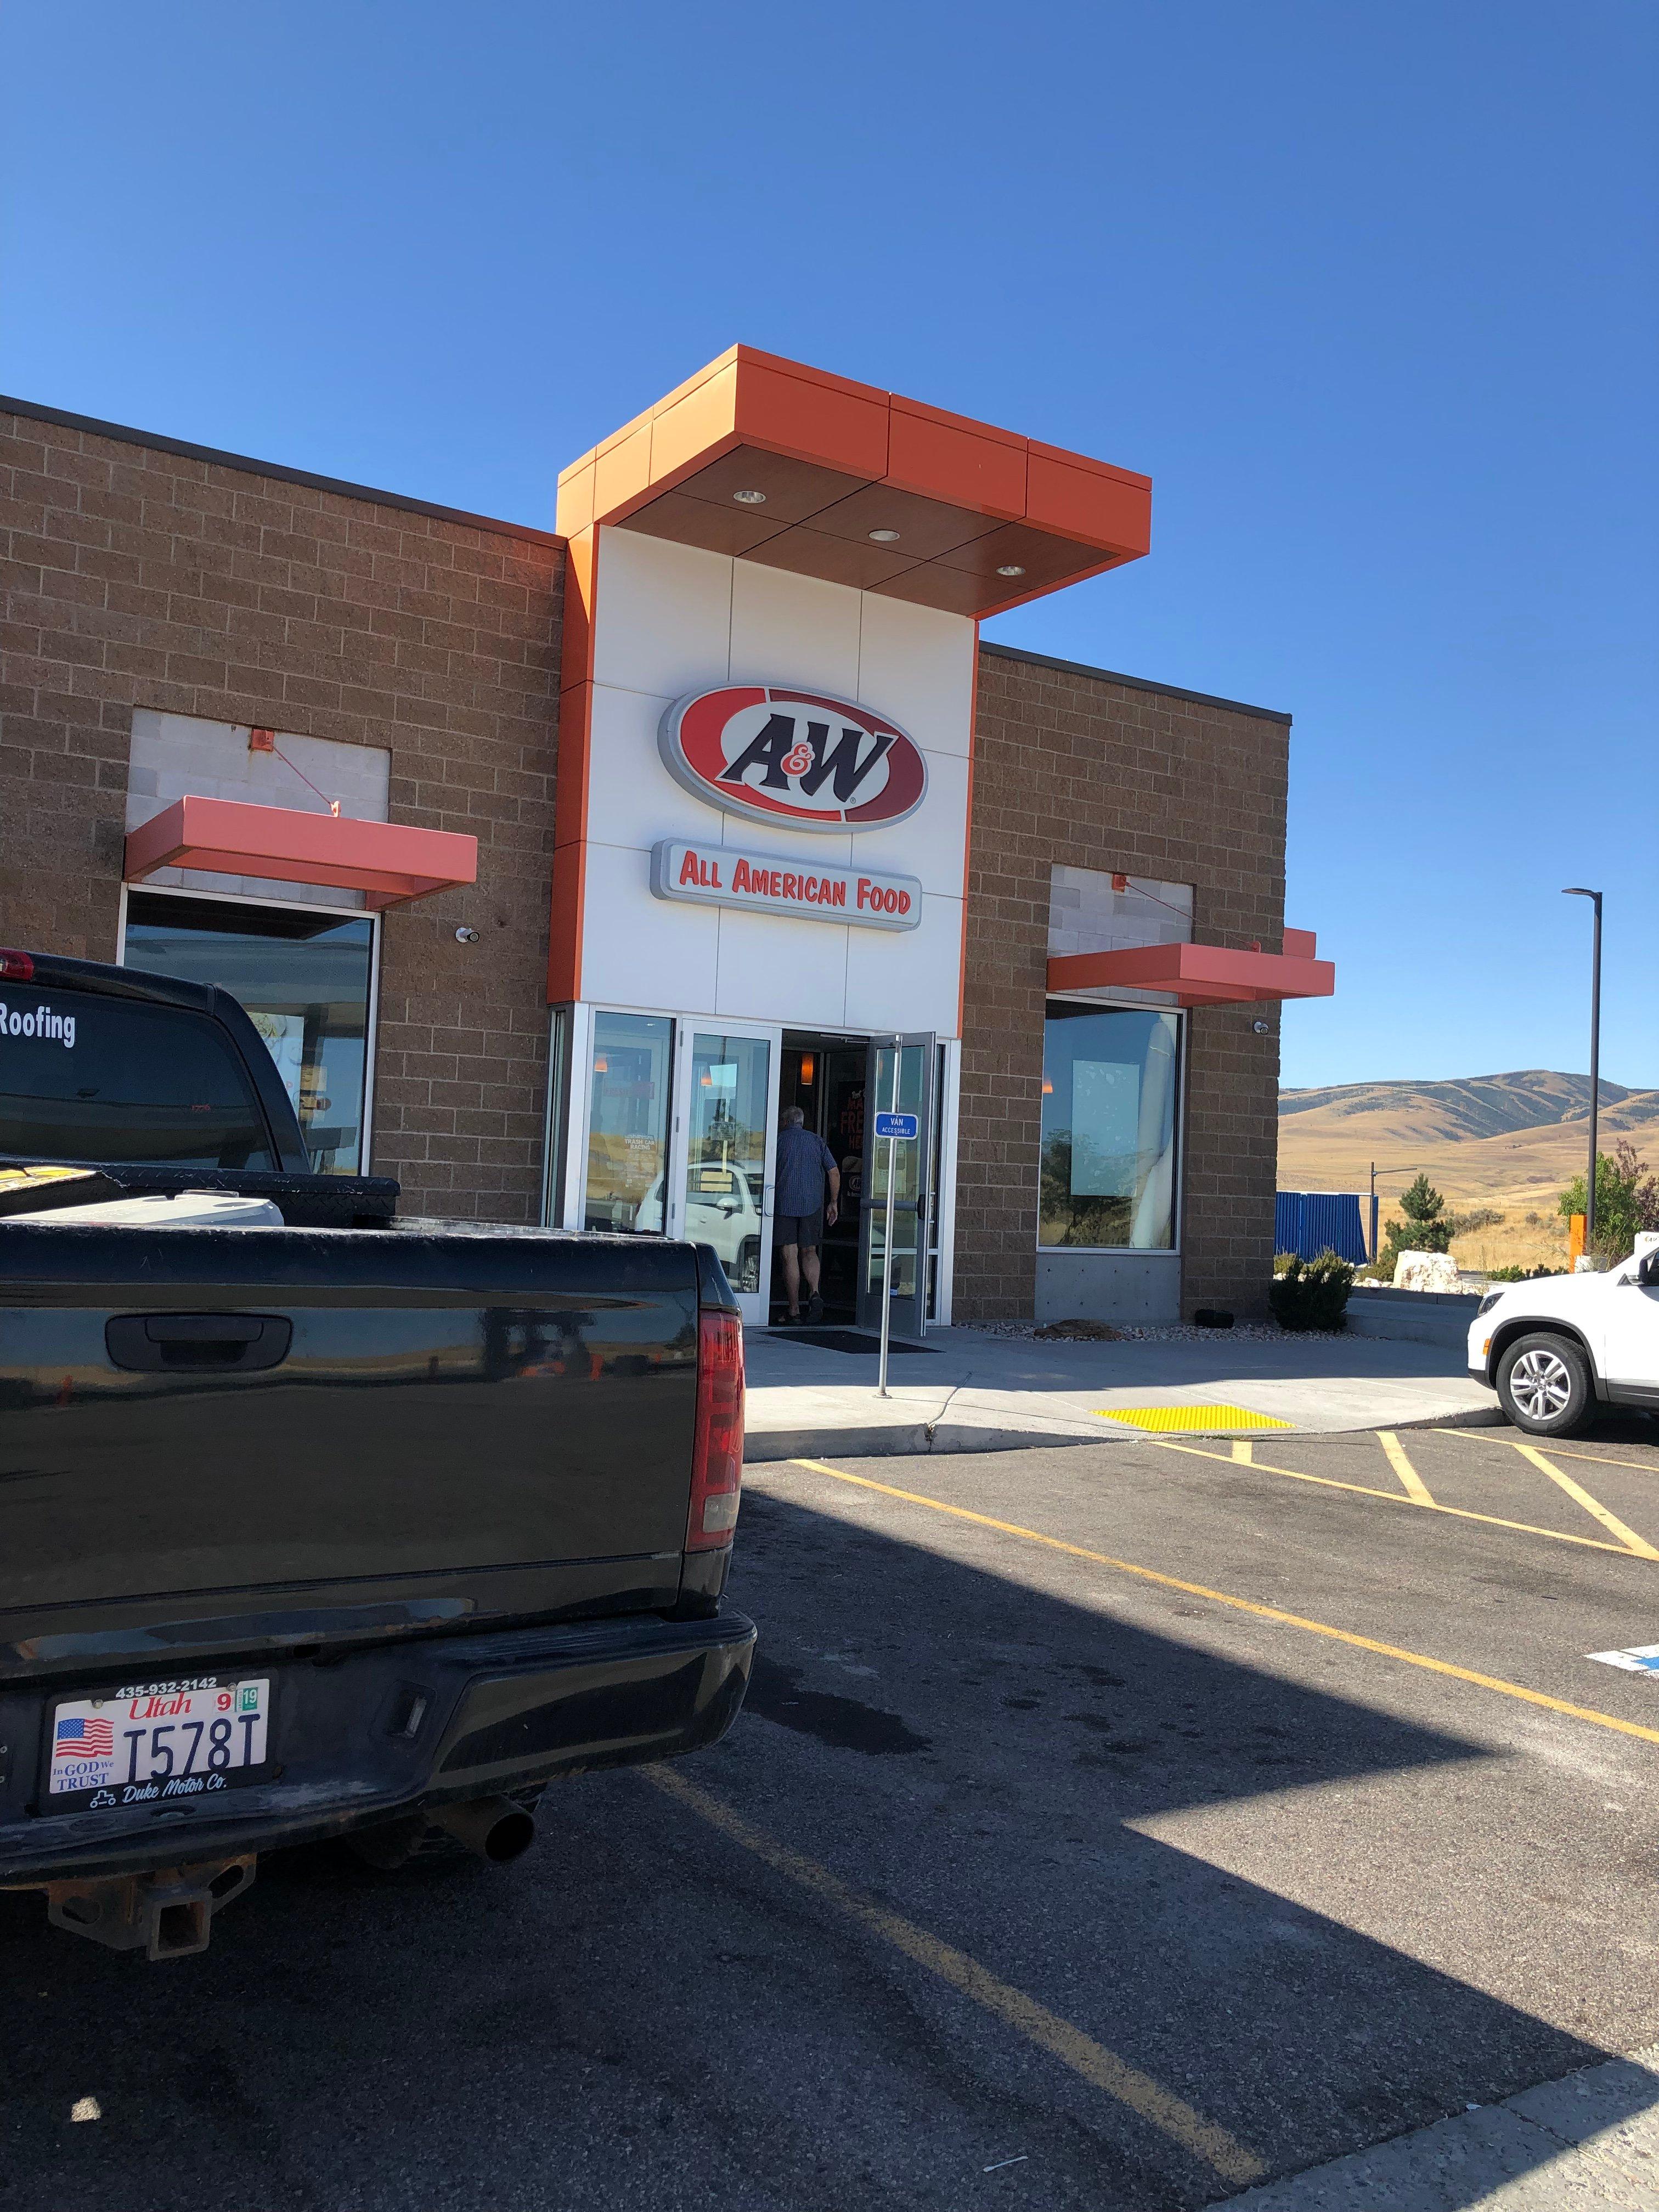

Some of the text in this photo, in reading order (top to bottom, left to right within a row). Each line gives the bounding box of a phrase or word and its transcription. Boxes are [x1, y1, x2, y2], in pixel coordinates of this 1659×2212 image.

[722, 713, 895, 803] A&W
[679, 850, 911, 915] ALL AMERICAN FOOD
[0, 1002, 75, 1048] Roofing
[890, 1118, 904, 1126] VAN
[115, 1677, 217, 1699] 435-932-2142
[244, 1689, 257, 1705] 19
[129, 1691, 191, 1720] Utah
[217, 1693, 232, 1711] 9
[123, 1713, 261, 1782] T578T
[64, 1761, 99, 1776] GOD
[57, 1772, 109, 1791] TRUST
[122, 1773, 227, 1803] Duke Motor Co.
